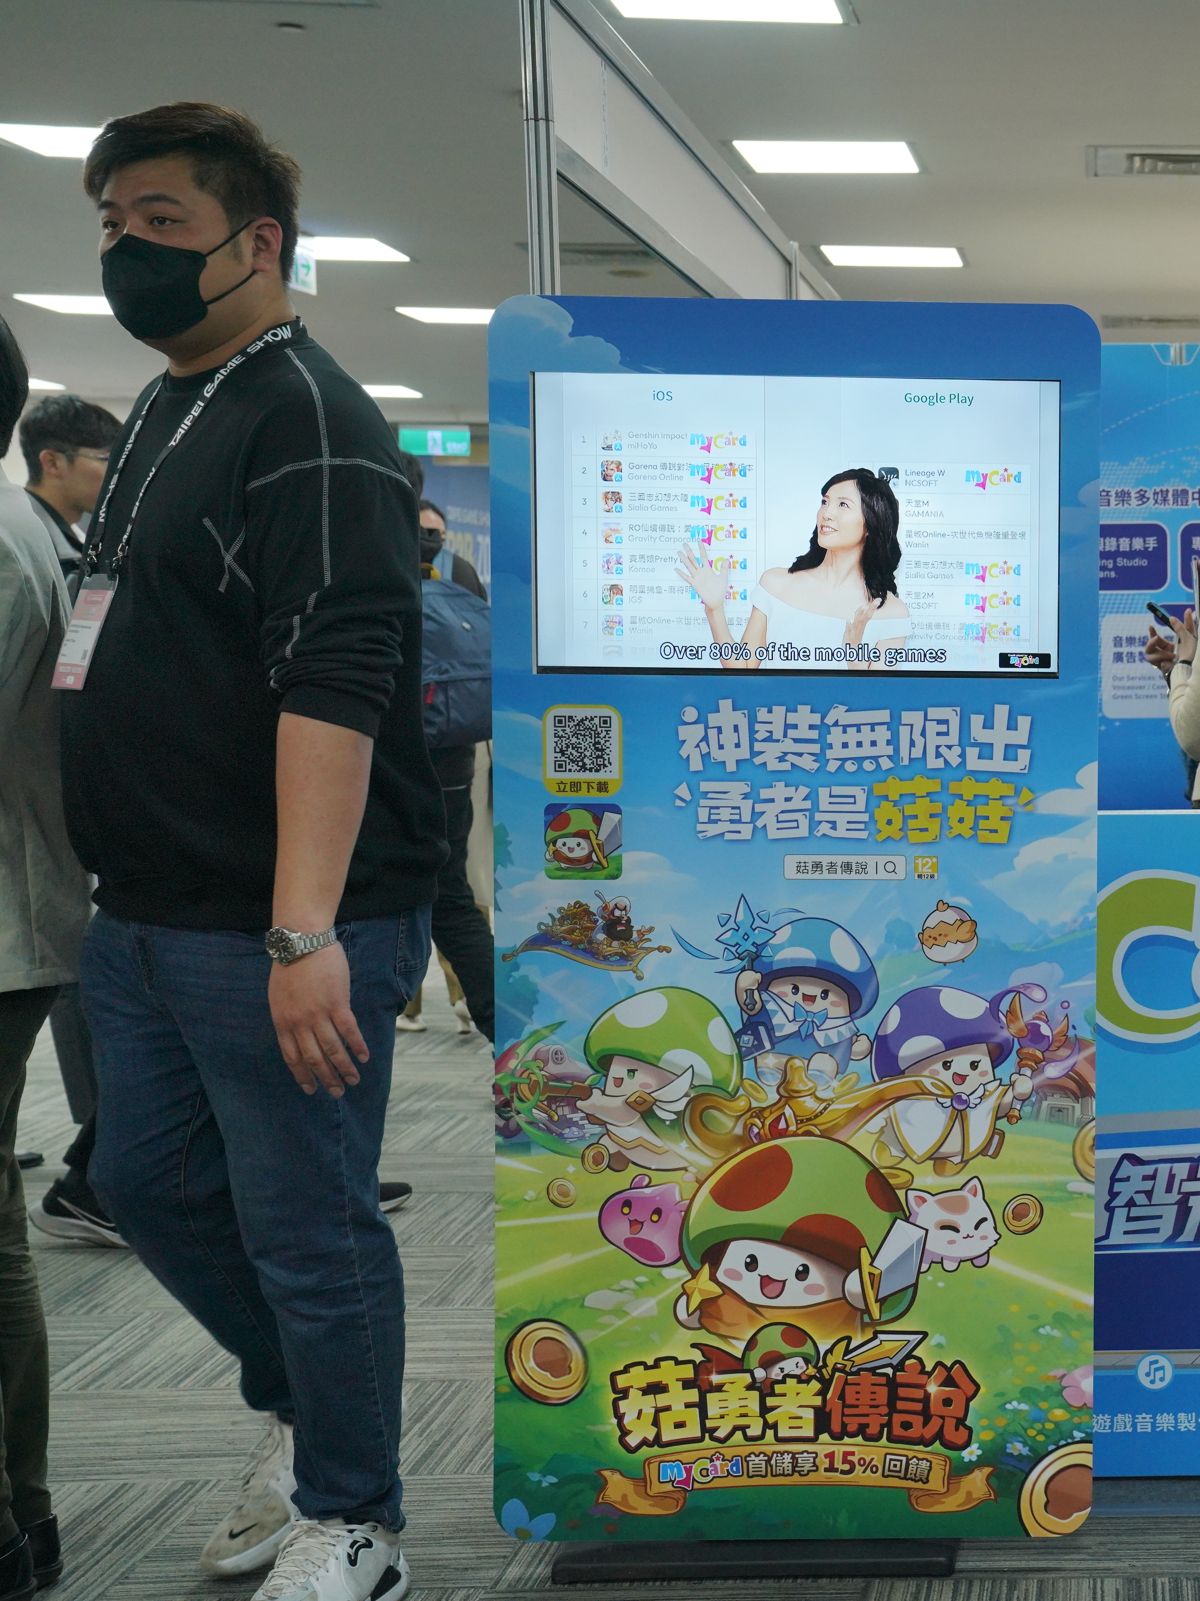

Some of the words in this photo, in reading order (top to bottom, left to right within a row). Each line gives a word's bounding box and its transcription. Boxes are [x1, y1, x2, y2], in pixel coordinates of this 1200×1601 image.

[168, 400, 205, 447] TAIPEI
[203, 355, 245, 398] GAME
[247, 324, 292, 354] SHOW
[653, 390, 673, 401] iOS
[904, 392, 946, 406] Google
[949, 393, 974, 407] Play
[628, 432, 659, 440] Genshin
[661, 433, 688, 442] Impact
[628, 463, 657, 471] Garena
[905, 469, 936, 478] Lineage
[659, 474, 683, 482] Online
[1117, 557, 1148, 567] Studio
[660, 642, 706, 660] Over
[709, 643, 750, 660] 80%
[755, 642, 777, 661] of
[778, 643, 811, 661] the
[814, 642, 881, 662] mobile
[885, 647, 947, 666] games
[678, 699, 1032, 774] 神裝無限出
[555, 781, 609, 794] 立即下載
[696, 775, 1016, 844] 勇者是菇菇
[795, 859, 870, 876] 菇勇者傳說
[612, 1357, 979, 1451] 菇勇者傳說
[747, 1453, 817, 1478] 首儲享
[822, 1450, 879, 1476] 15%
[883, 1453, 932, 1484] 回饋
